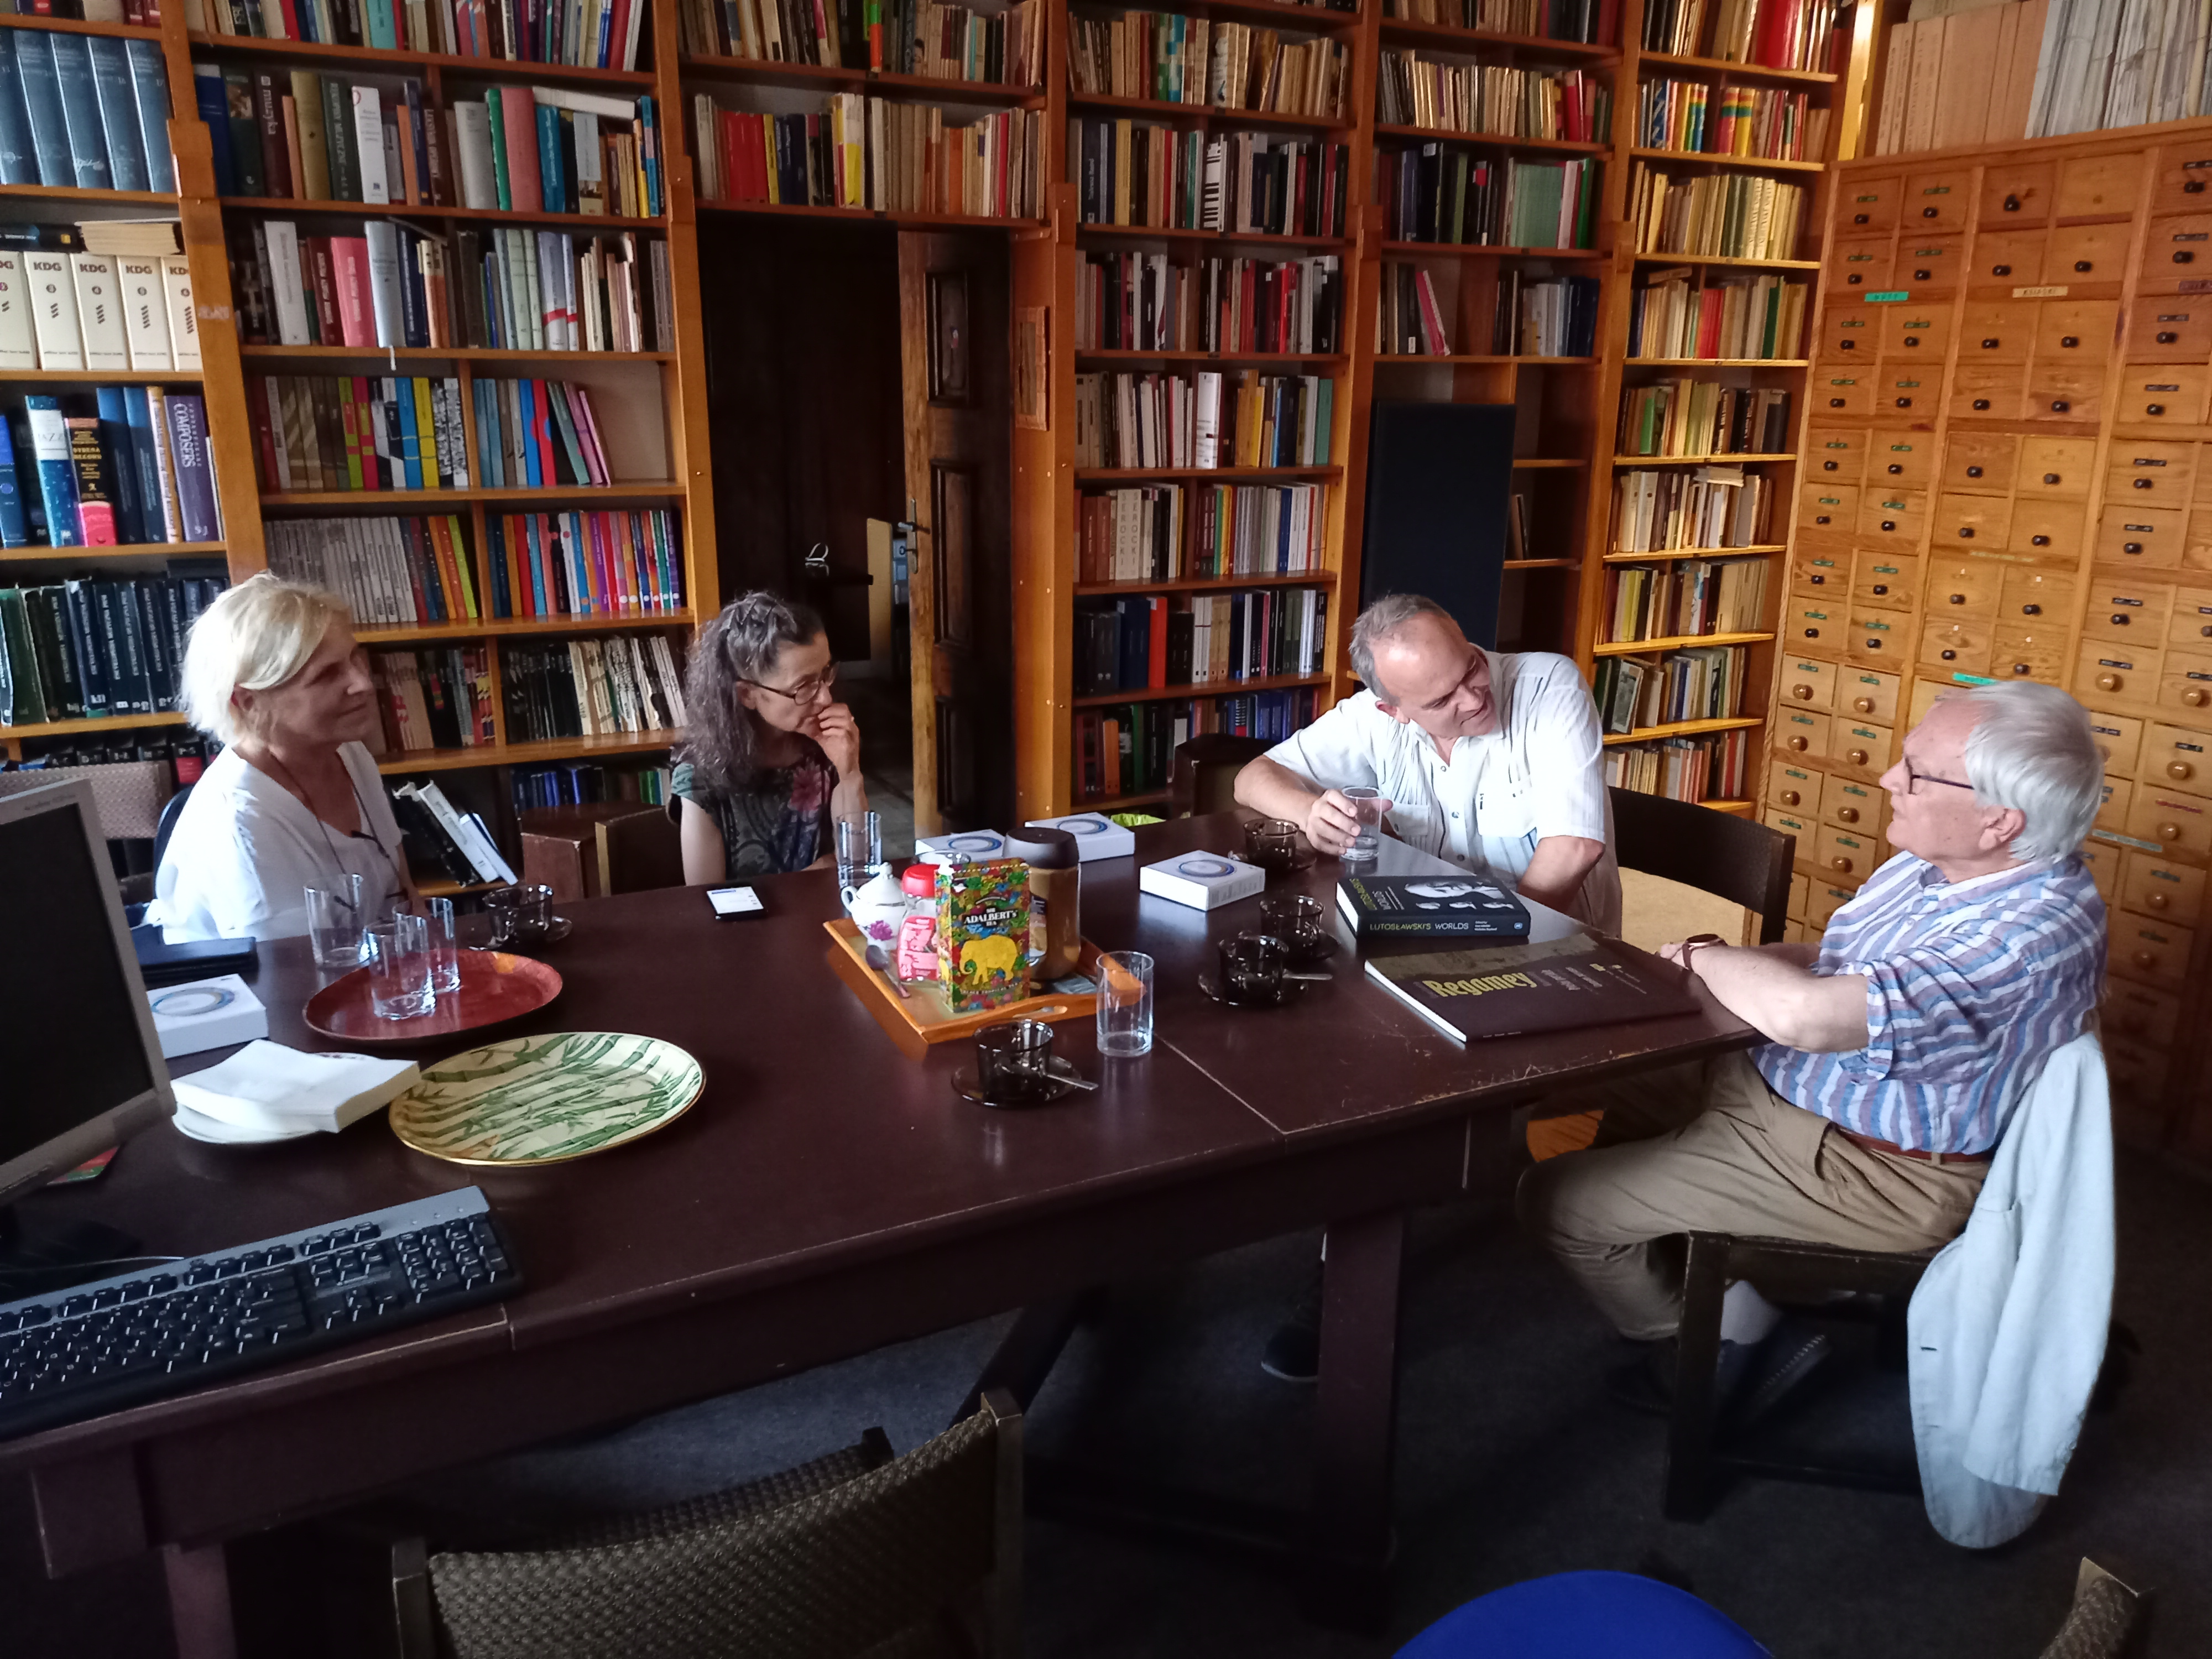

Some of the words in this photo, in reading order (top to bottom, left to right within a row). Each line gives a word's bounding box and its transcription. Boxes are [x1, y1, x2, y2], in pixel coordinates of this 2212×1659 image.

[33, 262, 62, 272] KDG
[79, 263, 107, 273] KDG
[126, 265, 153, 274] KDG
[169, 265, 189, 275] KD
[173, 403, 196, 468] COMPOSERS
[1369, 922, 1431, 931] LUTOSŁAWSKI'S
[1421, 971, 1538, 998] Regamey
